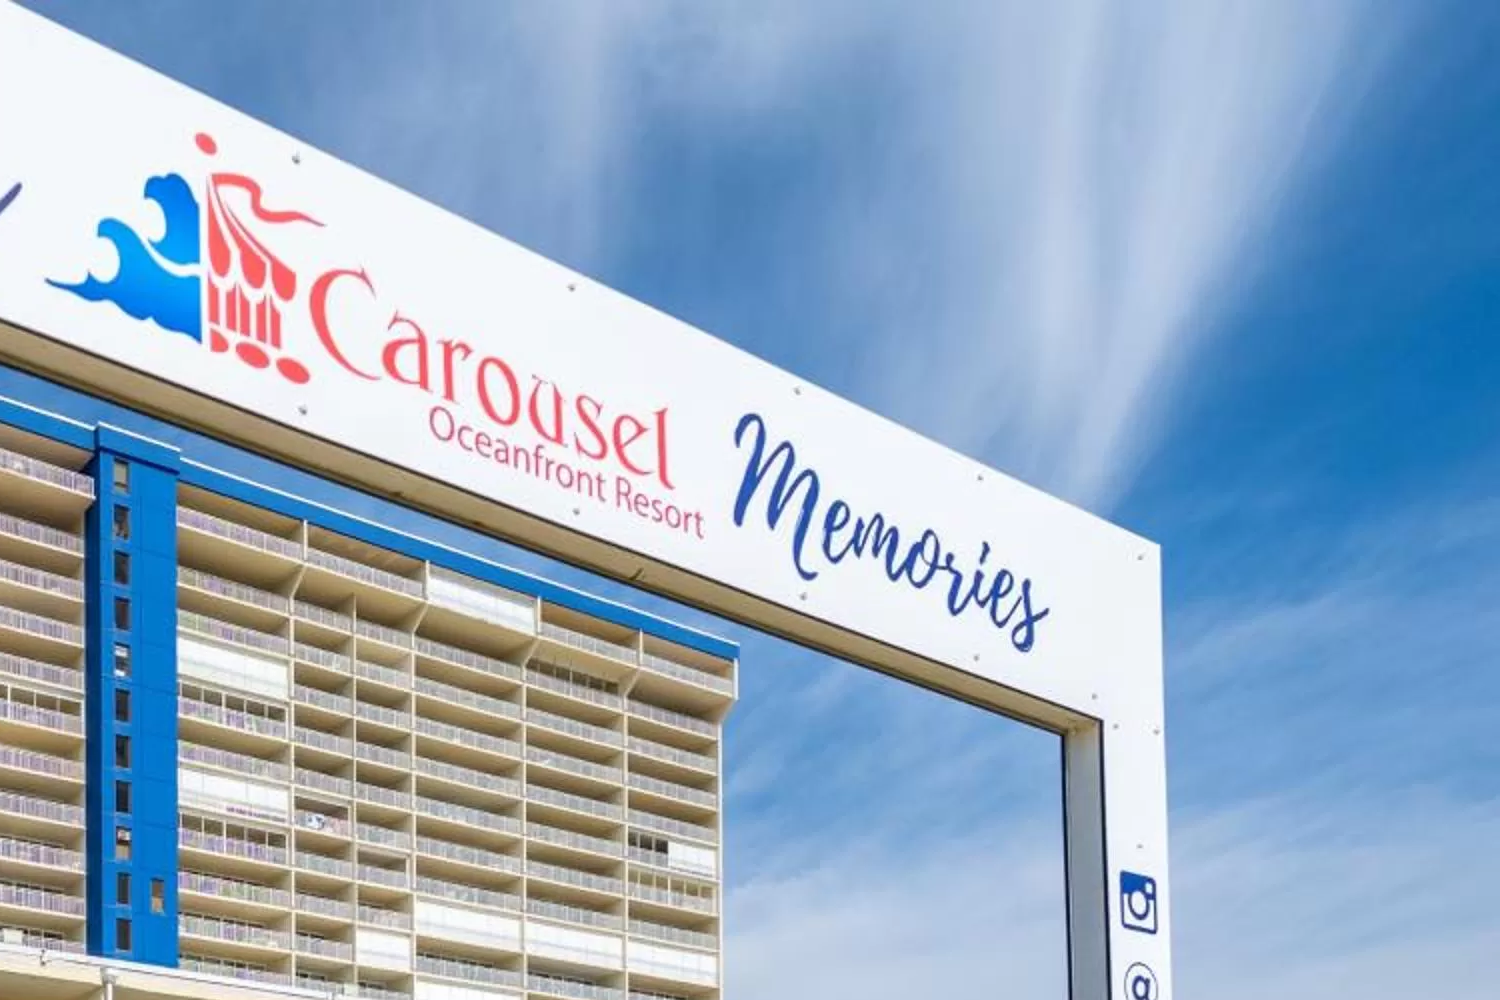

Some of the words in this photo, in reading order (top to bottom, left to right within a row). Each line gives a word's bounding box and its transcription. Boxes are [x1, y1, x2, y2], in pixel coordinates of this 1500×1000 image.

[309, 266, 676, 490] Carousel
[429, 405, 607, 502] Oceanfront
[615, 475, 705, 540] Resort
[733, 412, 1049, 652] Memories
